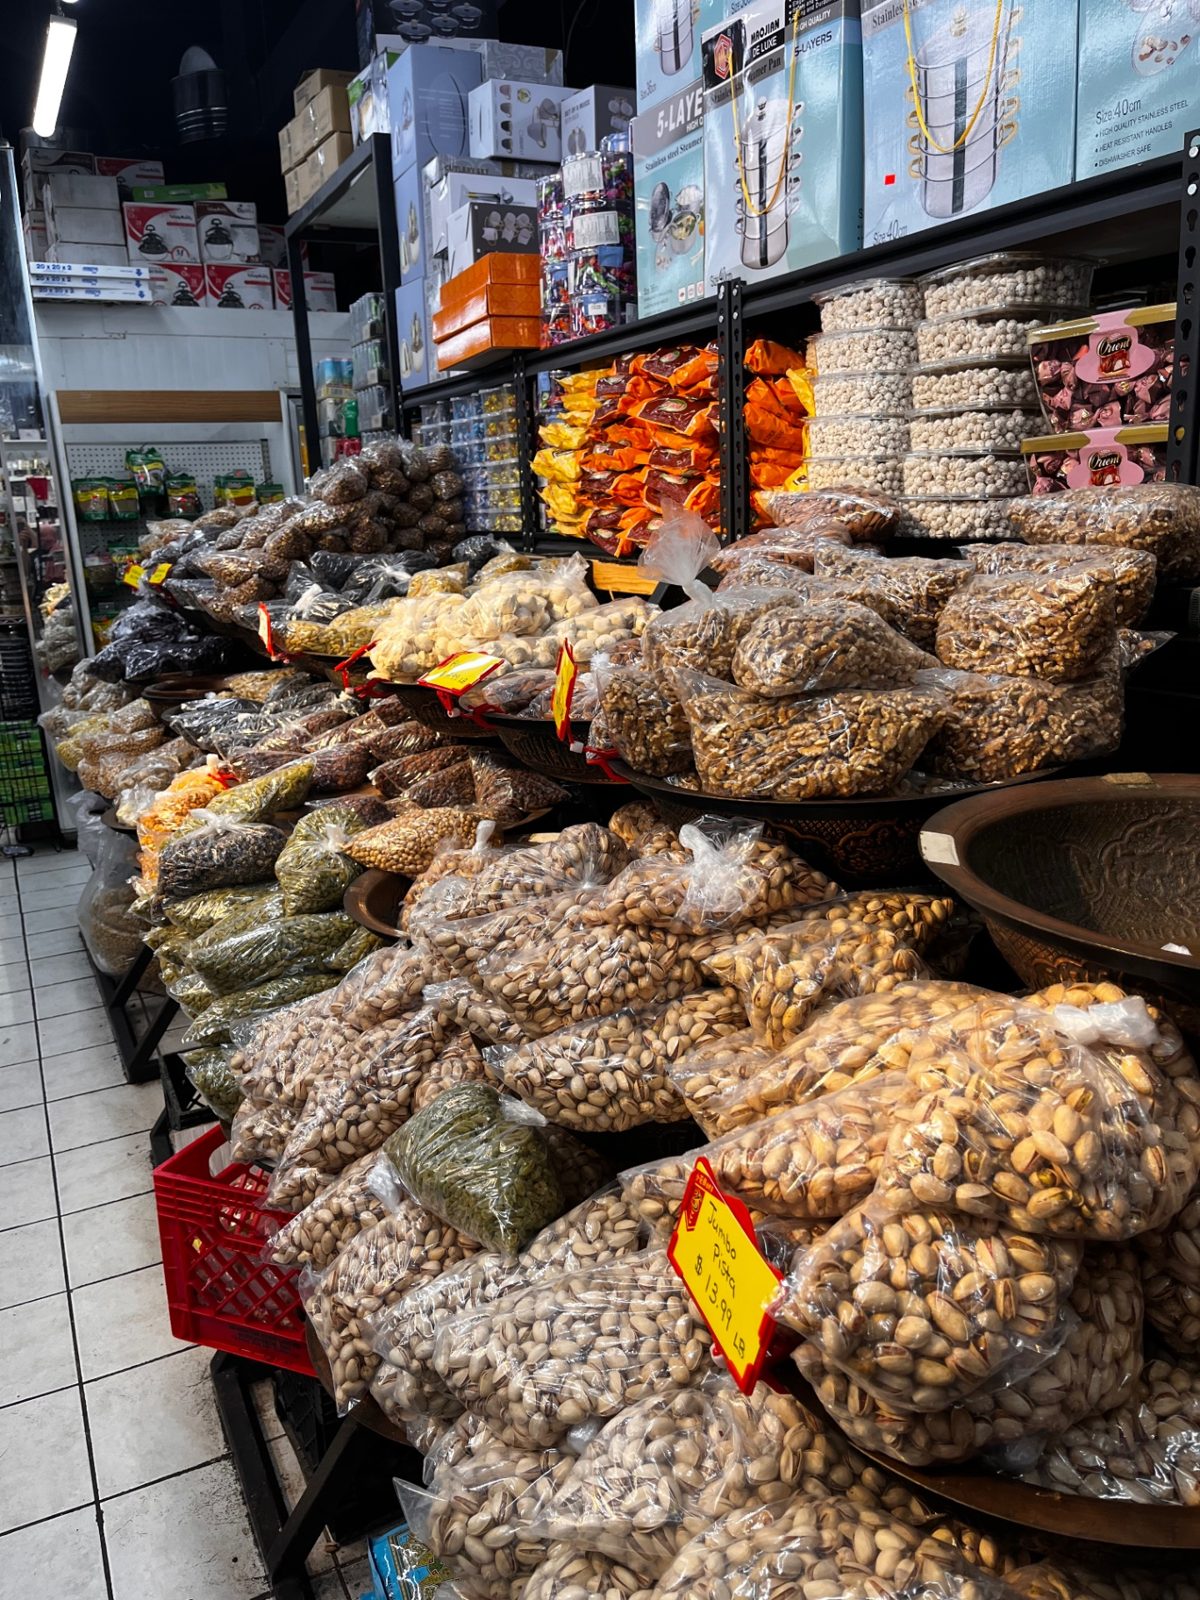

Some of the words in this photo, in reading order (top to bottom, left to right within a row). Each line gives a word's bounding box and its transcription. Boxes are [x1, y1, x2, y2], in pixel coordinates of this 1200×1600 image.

[807, 10, 831, 26] QUALITY
[872, 3, 905, 28] Stainles
[750, 18, 780, 42] MAOJIAN
[752, 46, 760, 58] DE
[760, 36, 777, 53] LUXE
[794, 31, 832, 57] 5-LAYERS
[768, 58, 782, 71] Pan
[1095, 98, 1142, 125] Size:40cm
[1099, 125, 1113, 137] HIGH
[1113, 117, 1136, 132] QUALITY
[1138, 107, 1169, 121] STAINLESS
[1169, 99, 1189, 112] STEEL
[686, 119, 699, 133] HIGH
[1099, 141, 1114, 152] HEAT
[1113, 132, 1144, 146] RESISTANT
[1144, 121, 1173, 136] HANDLES
[645, 155, 667, 172] Stainless
[667, 147, 680, 161] steel
[680, 136, 703, 153] Steamer
[1098, 150, 1136, 167] DISHWASHER
[1136, 143, 1152, 155] SAFE
[1088, 452, 1121, 470] Orient
[708, 1200, 737, 1260] Jumbo
[694, 1253, 703, 1277] $
[705, 1274, 733, 1332] 13.99
[733, 1332, 746, 1359] LB
